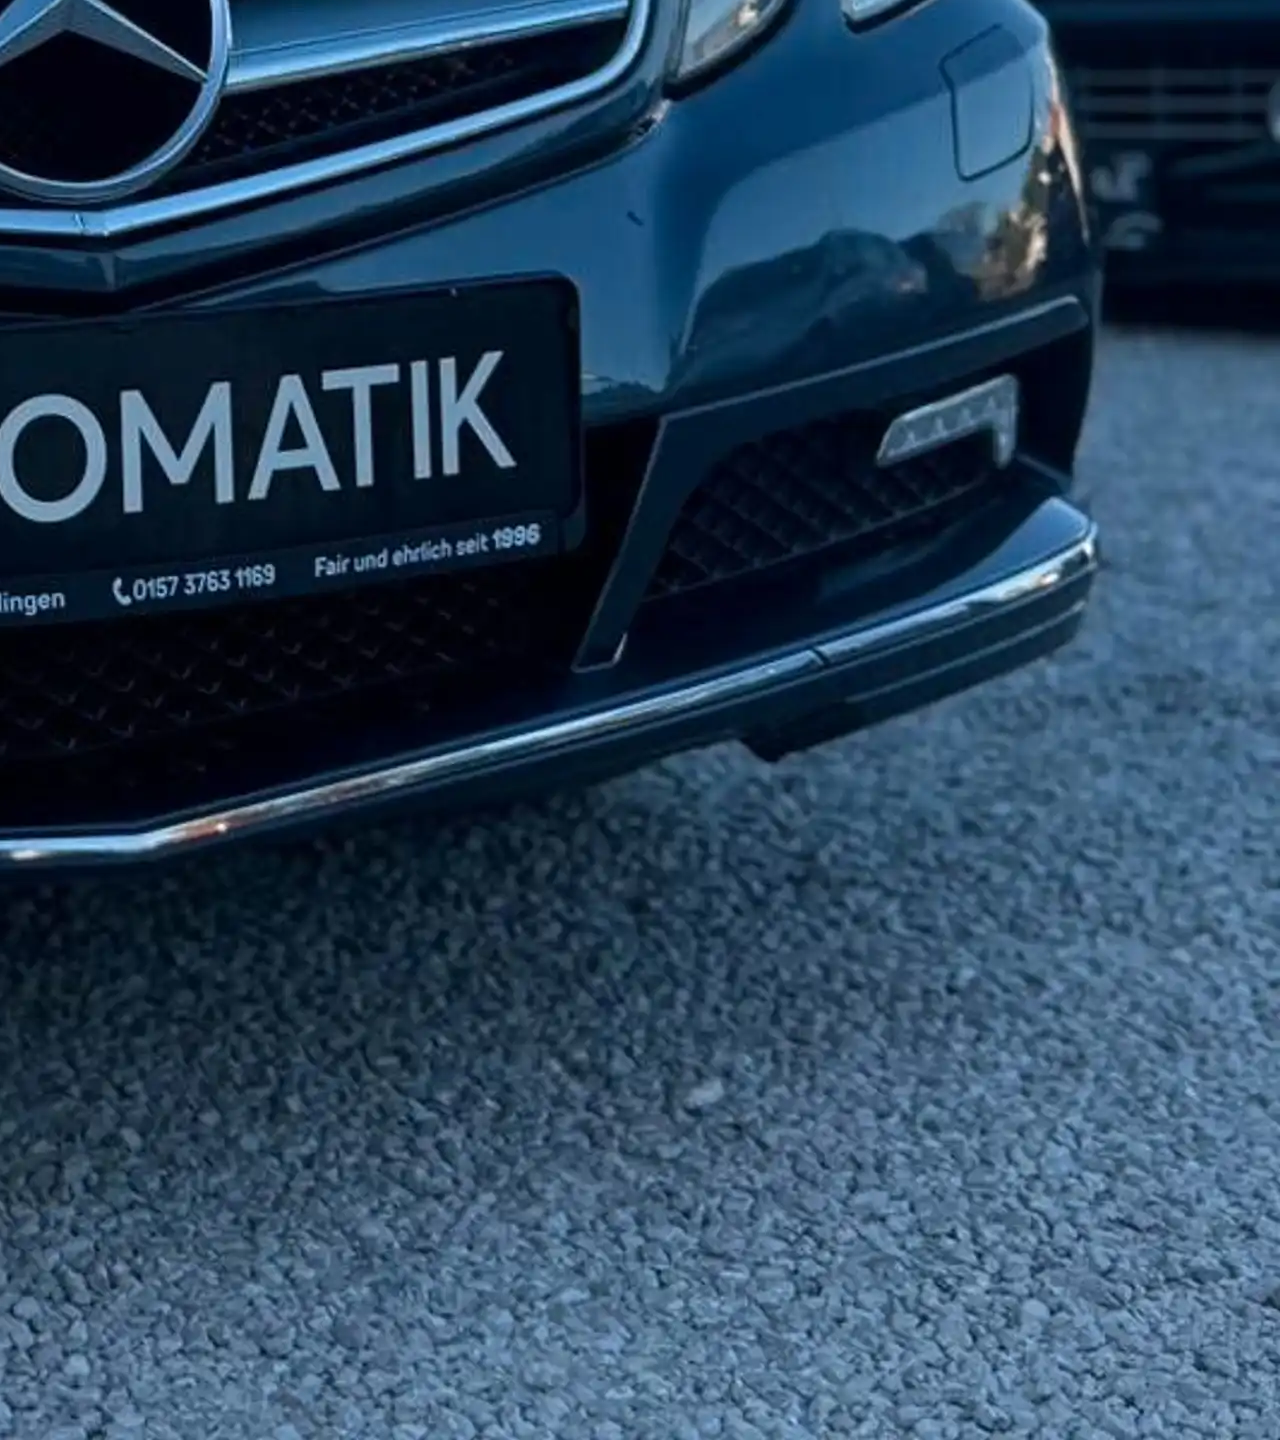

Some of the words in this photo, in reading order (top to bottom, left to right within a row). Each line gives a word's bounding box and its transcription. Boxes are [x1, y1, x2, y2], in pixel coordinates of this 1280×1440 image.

[314, 555, 350, 577] Fair
[354, 548, 388, 572] und
[392, 537, 452, 566] ehrlich
[456, 532, 489, 556] seit
[492, 523, 541, 550] 1996
[132, 575, 179, 601] 0157
[184, 569, 231, 594] 3763
[235, 563, 276, 588] 1169
